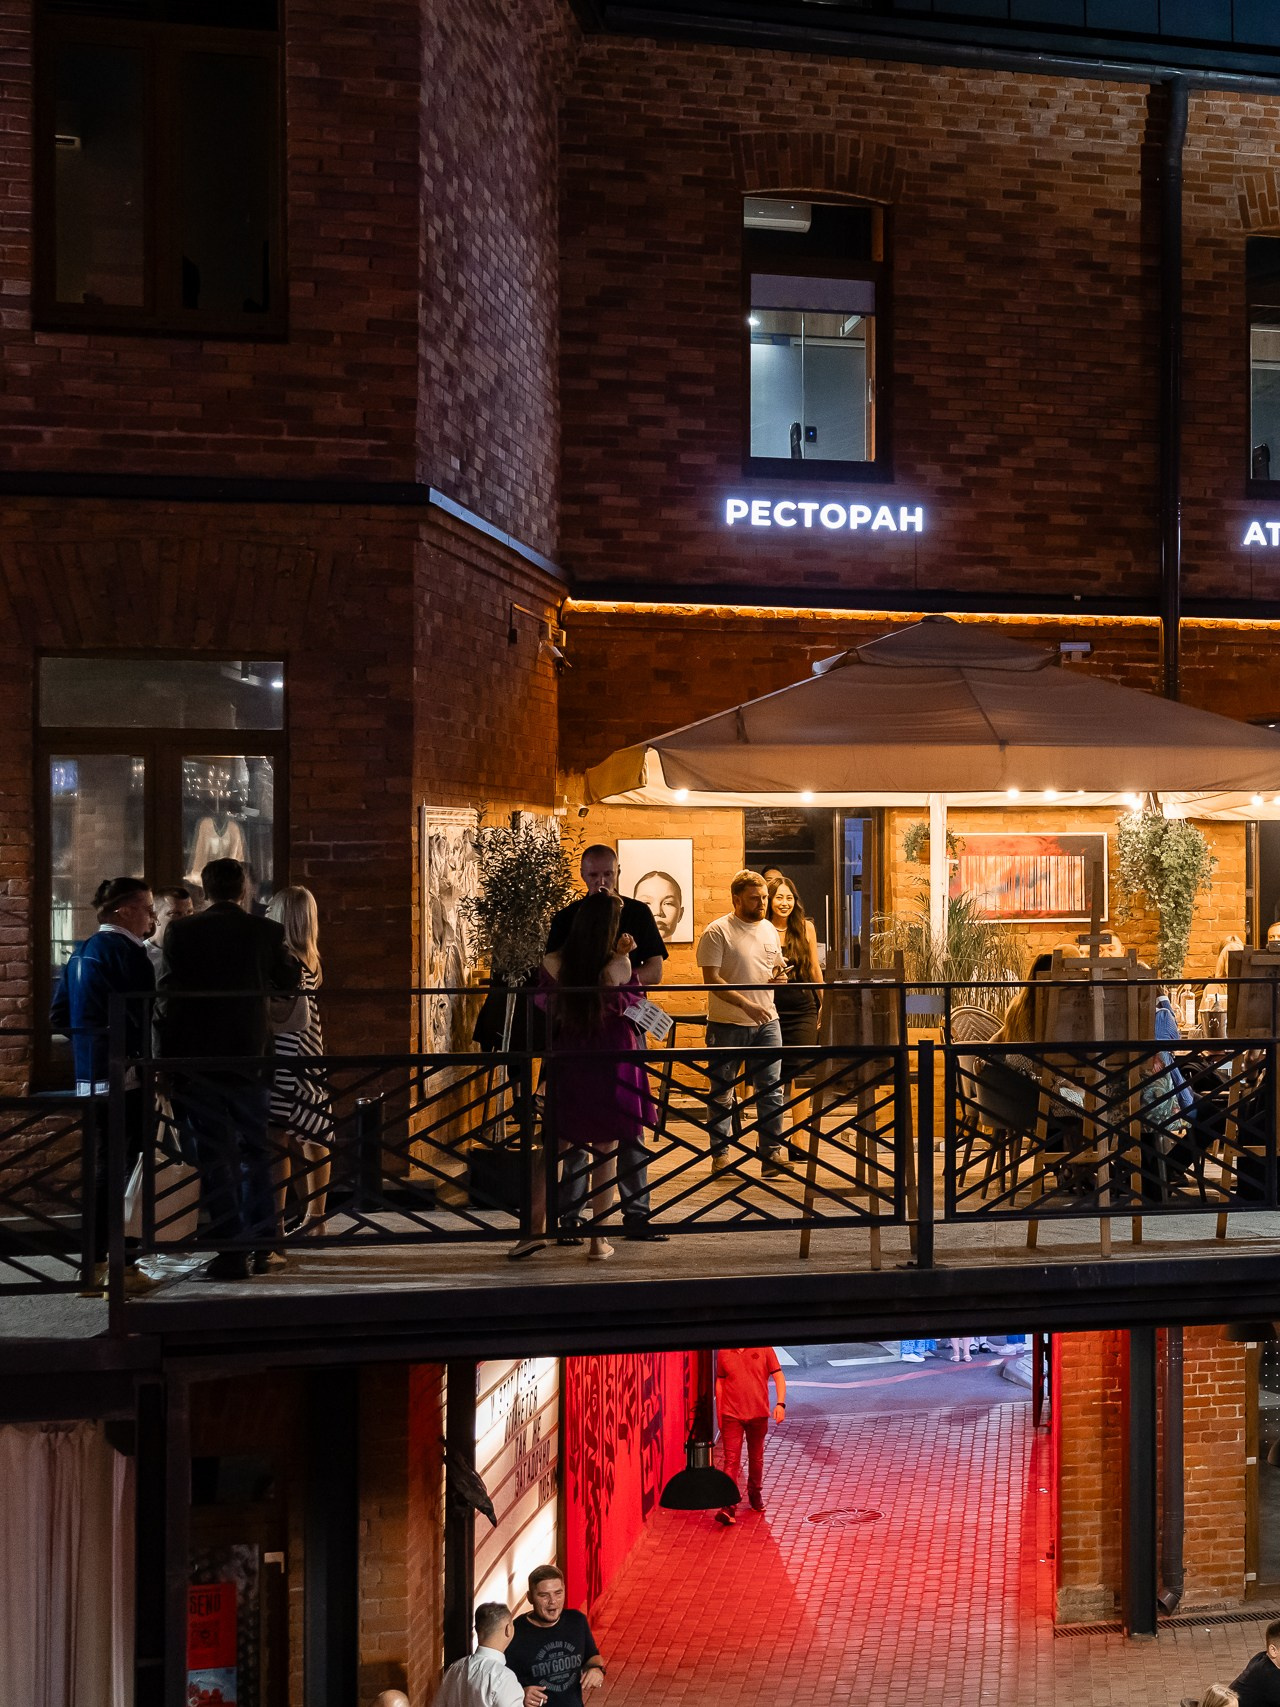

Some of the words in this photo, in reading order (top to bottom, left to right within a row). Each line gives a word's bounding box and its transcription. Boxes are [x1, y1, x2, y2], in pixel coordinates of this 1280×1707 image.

[726, 499, 923, 532] РЕСТОРАН
[531, 1661, 551, 1678] DRY
[552, 1654, 582, 1673] GOODS
